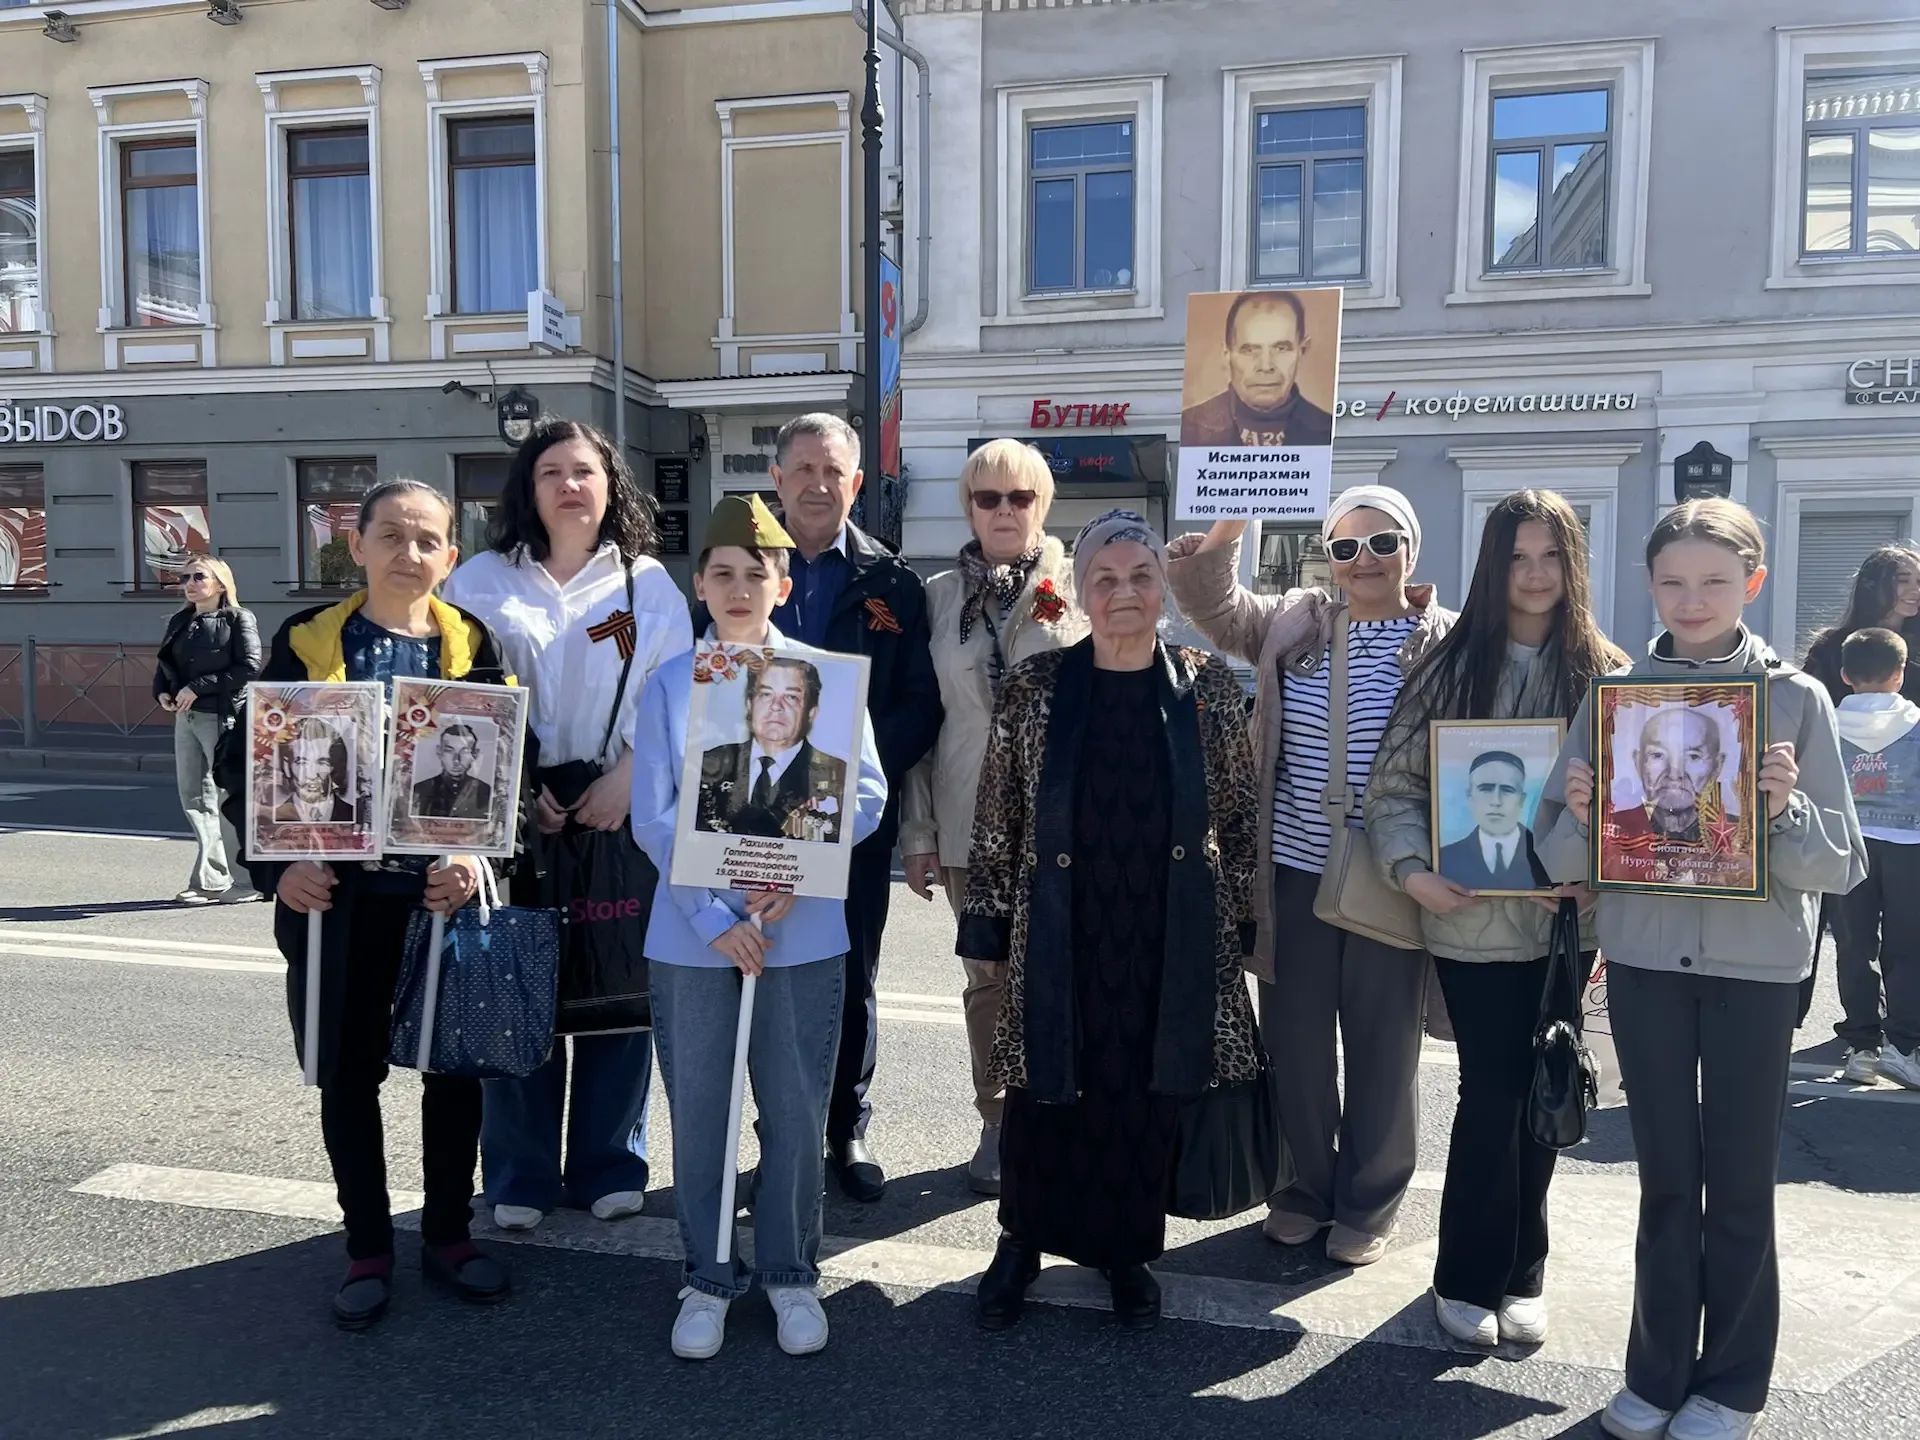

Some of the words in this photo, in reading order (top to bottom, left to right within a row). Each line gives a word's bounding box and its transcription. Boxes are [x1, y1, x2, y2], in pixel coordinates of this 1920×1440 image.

[1404, 389, 1637, 422] кофемашины
[1208, 452, 1300, 463] Исмагилов
[1196, 468, 1311, 482] Халилрахман
[1196, 486, 1309, 498] Исмагилович
[1188, 505, 1217, 514] 1908
[1220, 507, 1248, 515] года
[1252, 507, 1316, 516] рождения
[739, 837, 785, 850] Рахимов
[715, 867, 805, 883] 19.05.1925-16.03.1997
